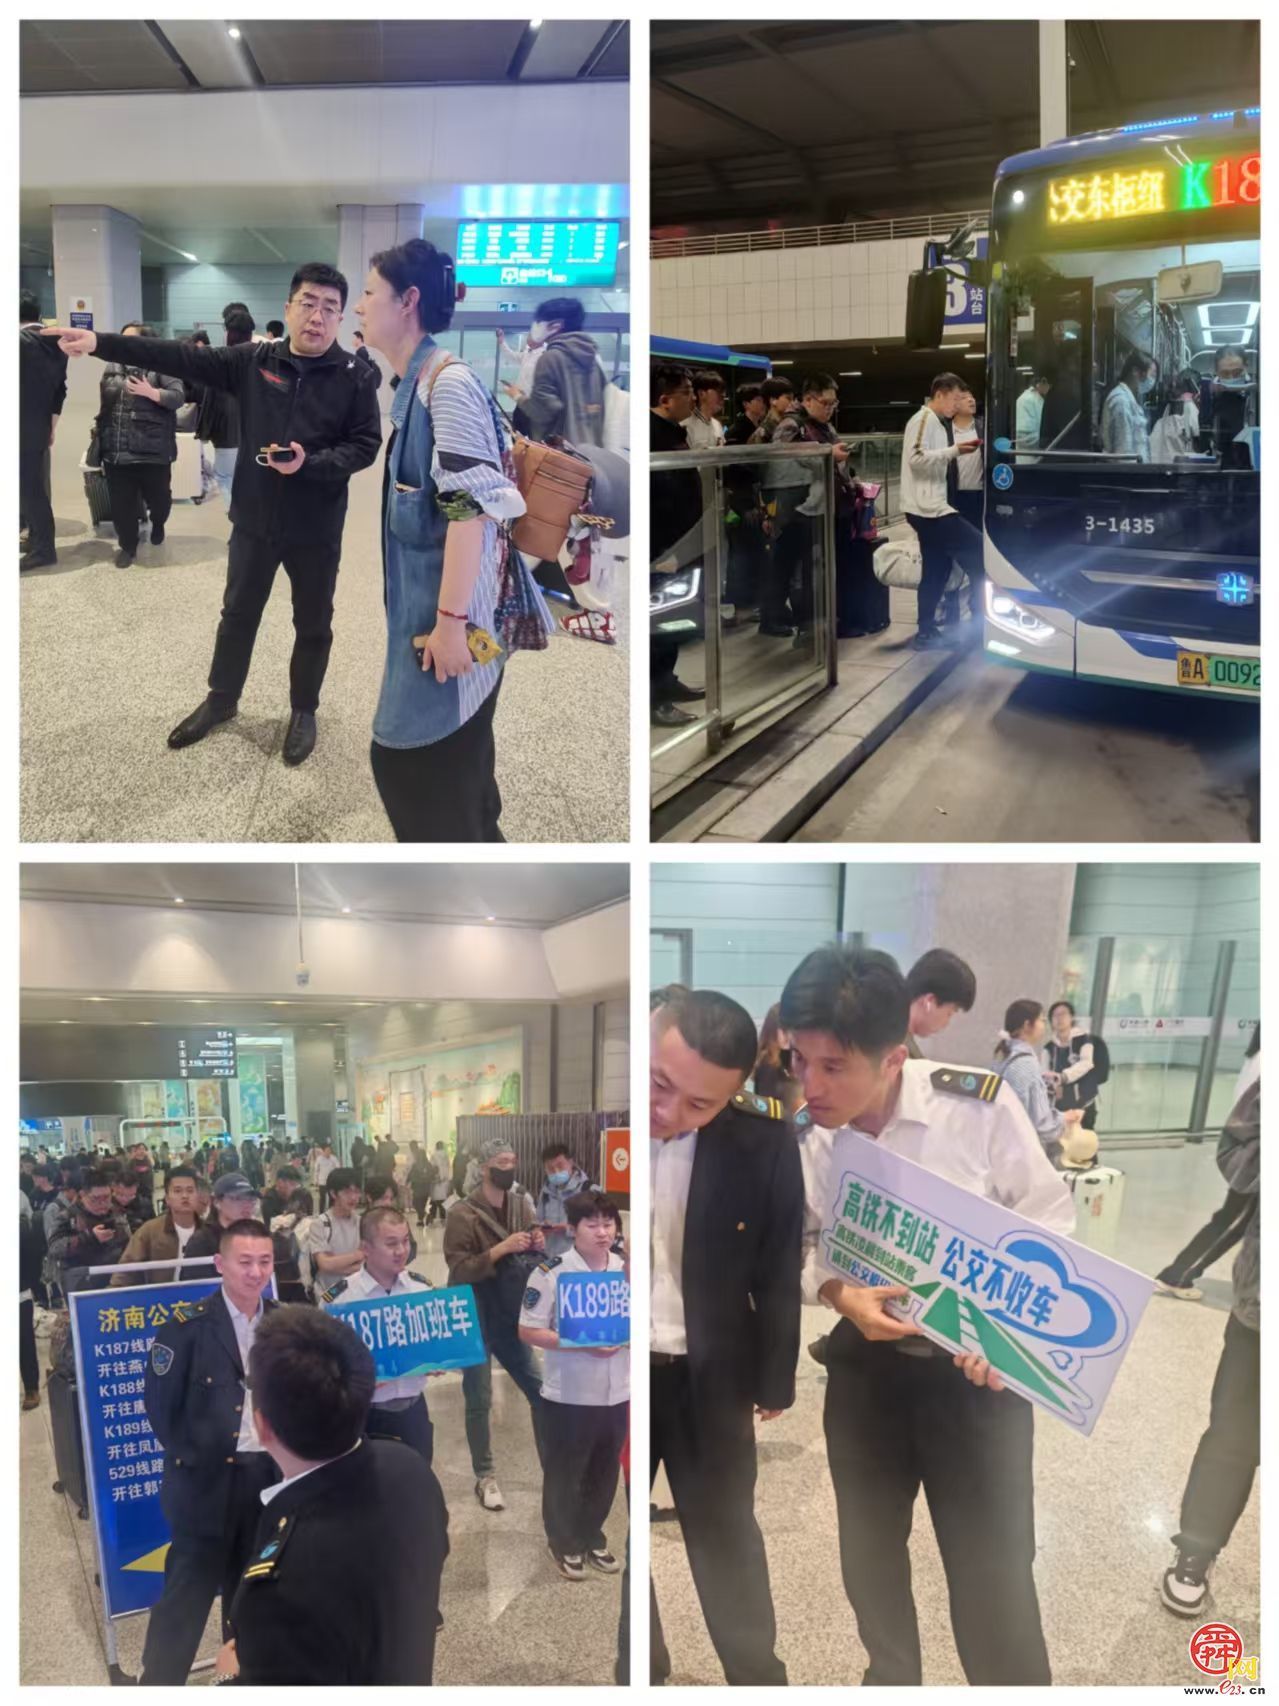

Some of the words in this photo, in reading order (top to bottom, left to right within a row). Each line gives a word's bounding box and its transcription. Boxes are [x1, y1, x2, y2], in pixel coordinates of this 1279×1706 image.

[970, 287, 983, 315] 站台
[1085, 516, 1155, 534] 3-1435
[842, 1182, 939, 1265] 高铁不到站
[939, 1236, 1058, 1327] 公交不收车
[559, 1280, 630, 1319] K189路
[333, 1295, 473, 1351] 187路加班车
[97, 1359, 147, 1378] 开往燕
[109, 1458, 164, 1480] 529线路
[112, 1480, 162, 1502] 开往郭
